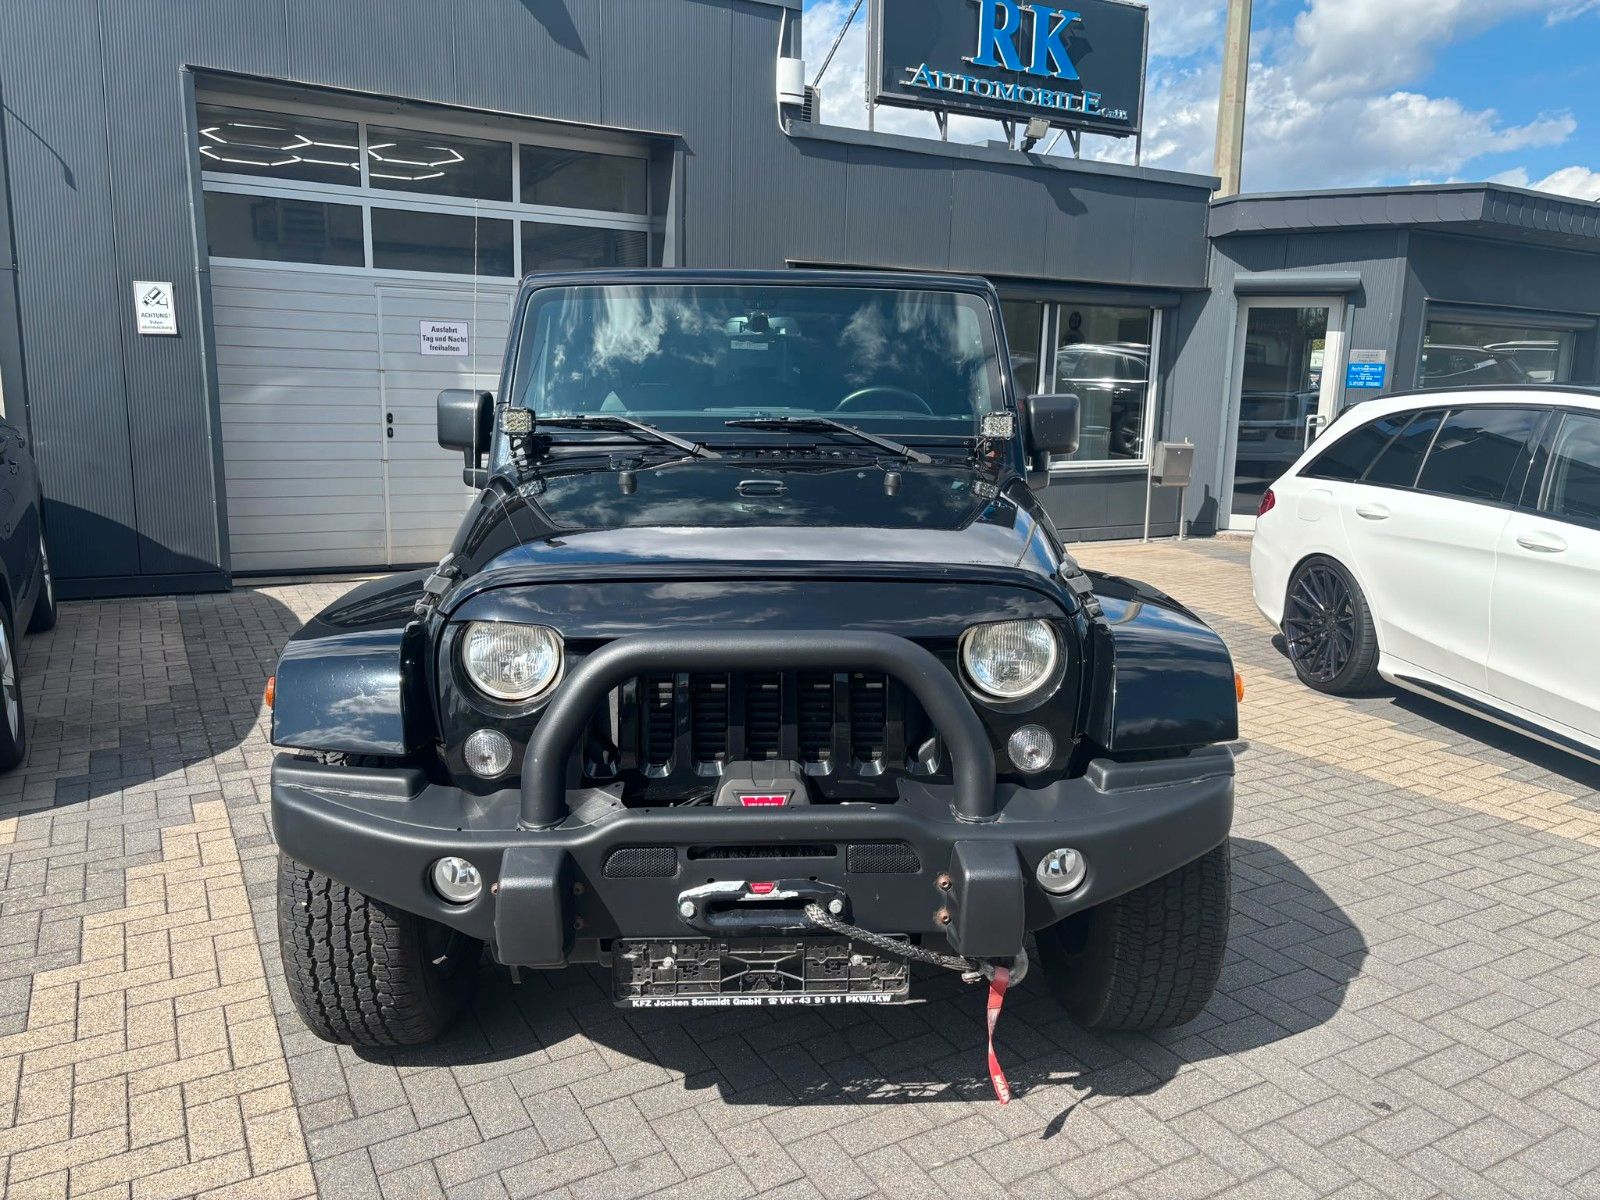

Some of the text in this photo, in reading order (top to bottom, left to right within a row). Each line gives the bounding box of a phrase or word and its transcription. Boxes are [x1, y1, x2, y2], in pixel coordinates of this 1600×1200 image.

[973, 0, 1081, 80] RK
[431, 325, 458, 334] Ausfahrt
[422, 335, 434, 343] Tag
[448, 335, 467, 343] Nacht
[429, 344, 460, 352] freihalten
[632, 999, 651, 1007] KFZ
[654, 999, 689, 1007] Jochen
[691, 998, 730, 1006] Schmidt
[733, 997, 761, 1006] GmbH
[846, 994, 892, 1003] PKW/LKW
